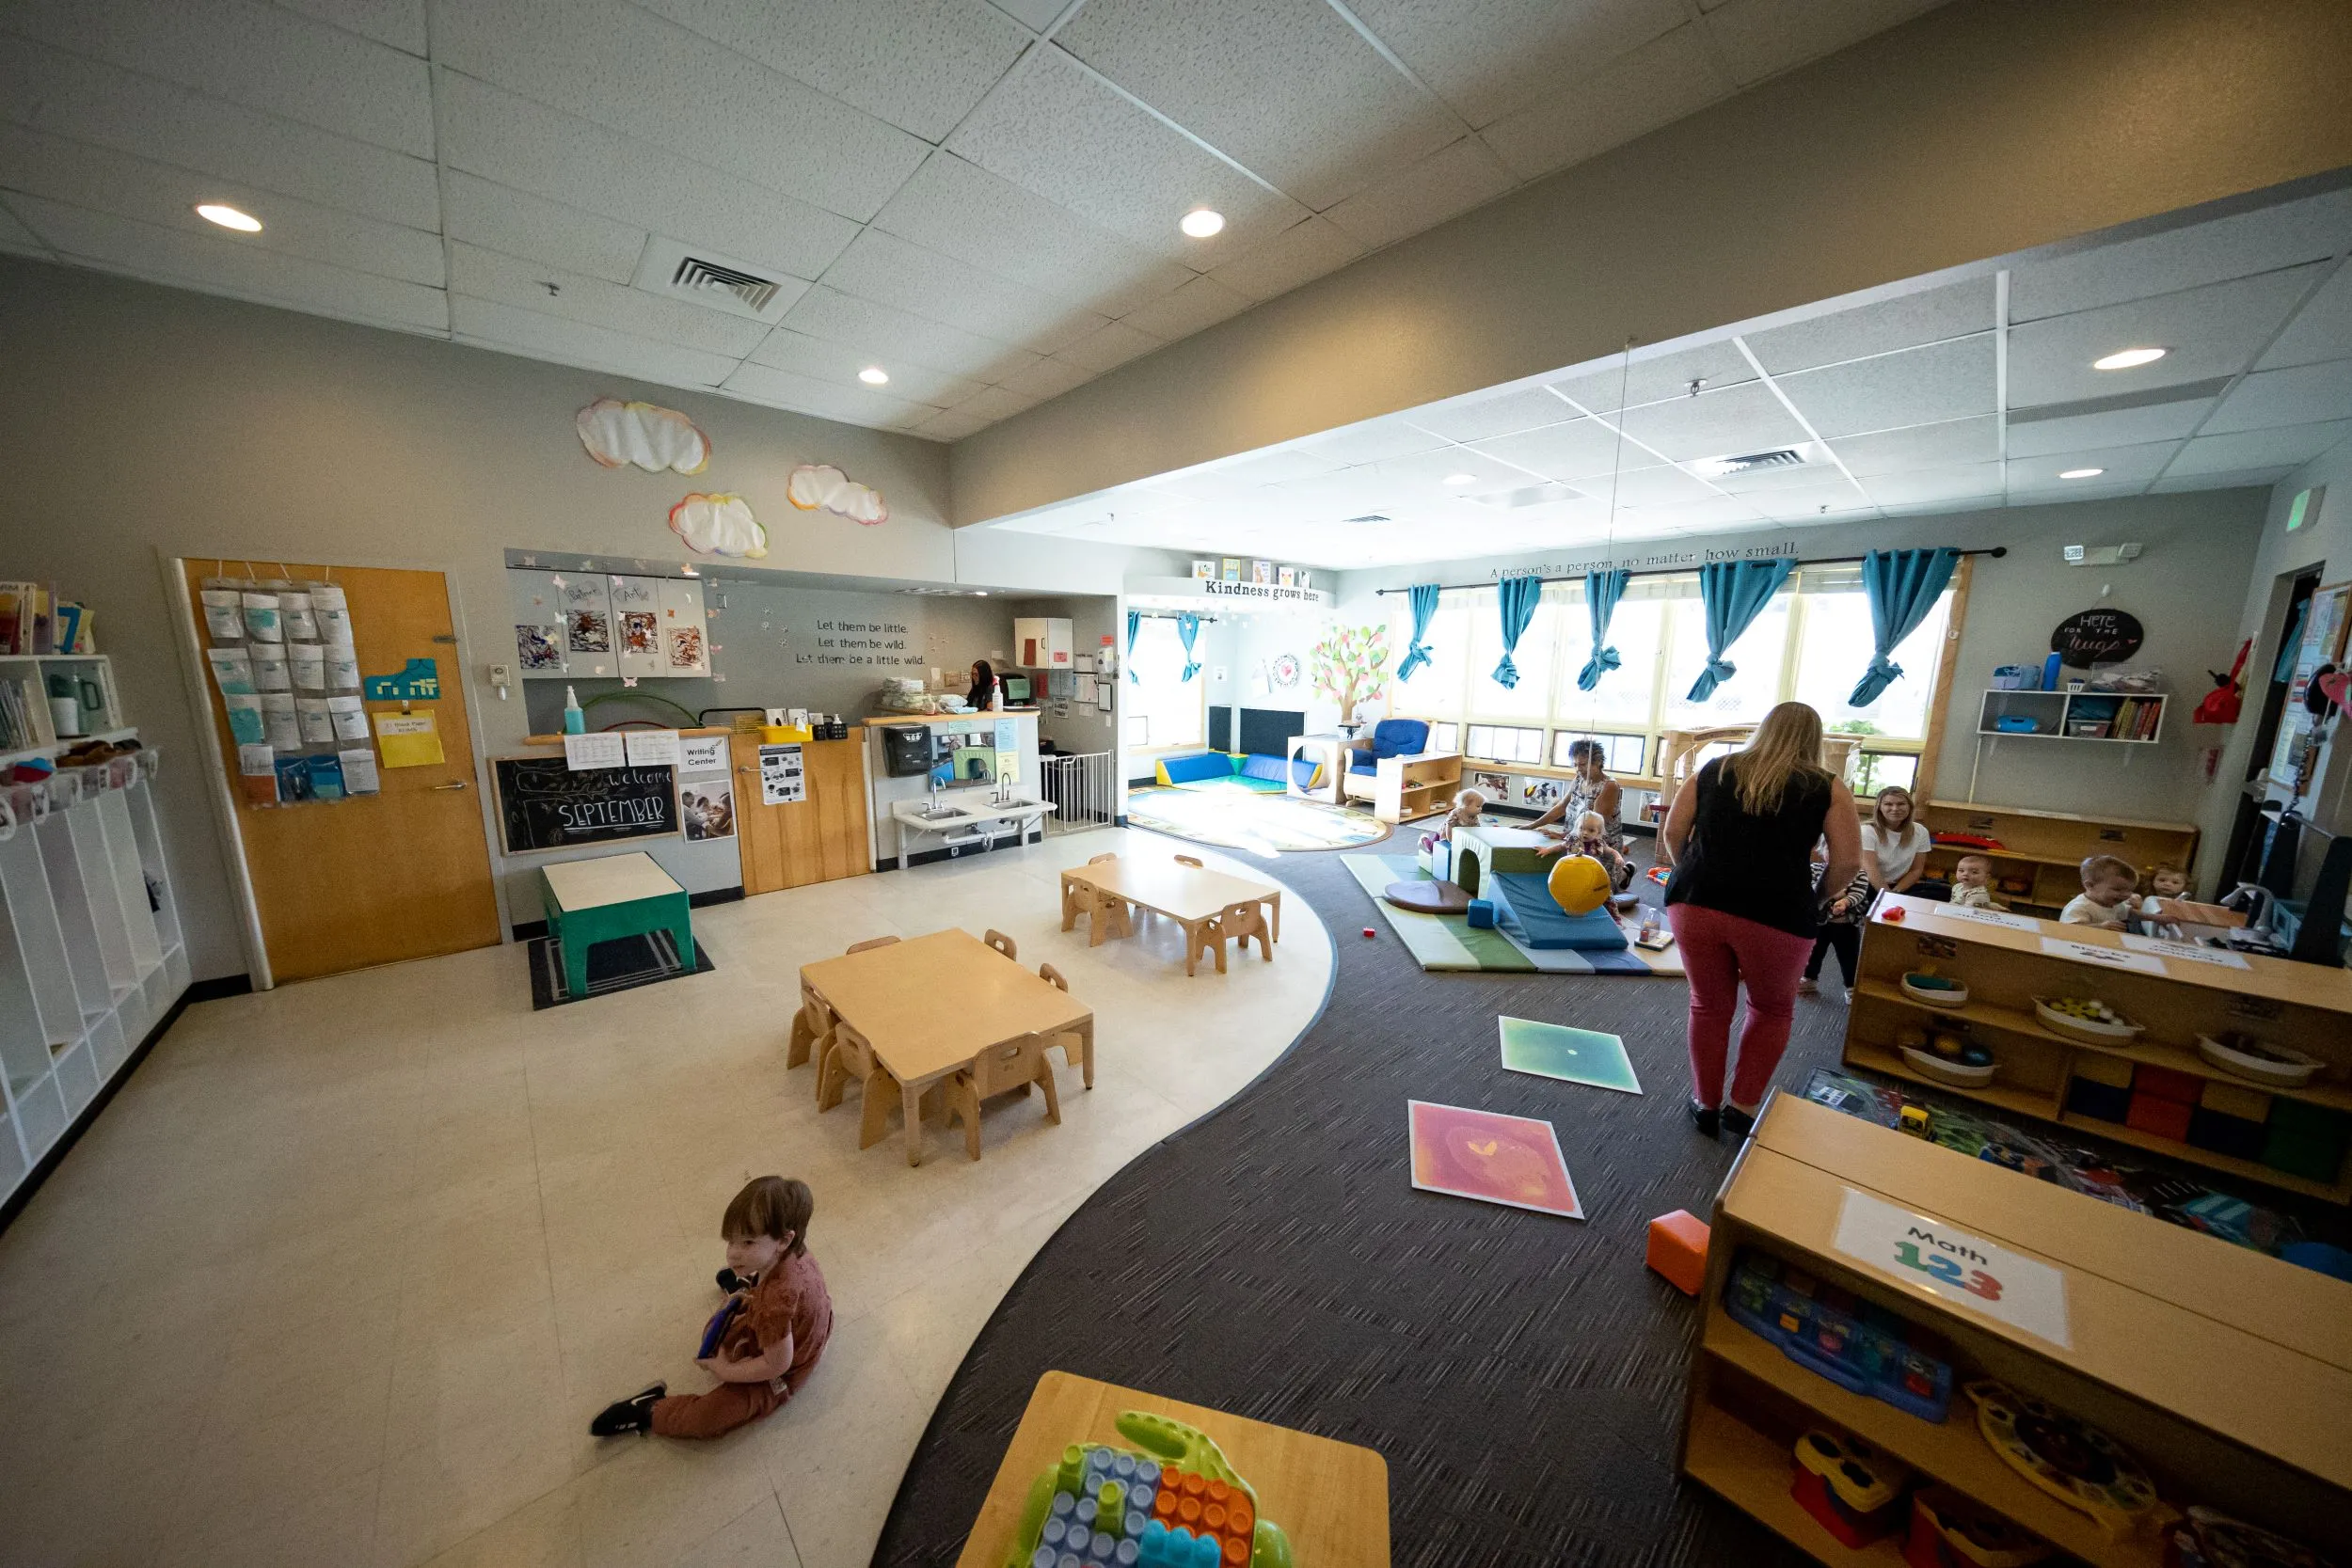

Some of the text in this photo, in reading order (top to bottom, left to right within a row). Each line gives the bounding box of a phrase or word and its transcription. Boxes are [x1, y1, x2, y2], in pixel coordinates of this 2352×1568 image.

[1490, 568, 1498, 578] A
[1555, 564, 1562, 573] a
[1622, 559, 1639, 568] no
[1646, 552, 1695, 565] matter
[1705, 548, 1740, 561] how
[1745, 541, 1800, 558] small.
[1205, 580, 1319, 602] Kindness grows here
[817, 620, 834, 630] Let
[838, 621, 866, 632] them
[868, 623, 881, 633] be
[818, 638, 907, 650] Let them be wild.
[796, 654, 813, 664] Let
[818, 654, 846, 664] them
[866, 657, 873, 665] a
[876, 656, 899, 665] little
[904, 656, 926, 665] wild.
[687, 748, 715, 756] Writing
[688, 757, 717, 766] Center
[559, 797, 664, 827] SEPTEMBER
[1908, 1227, 1988, 1266] Math
[1894, 1241, 2003, 1302] 123
